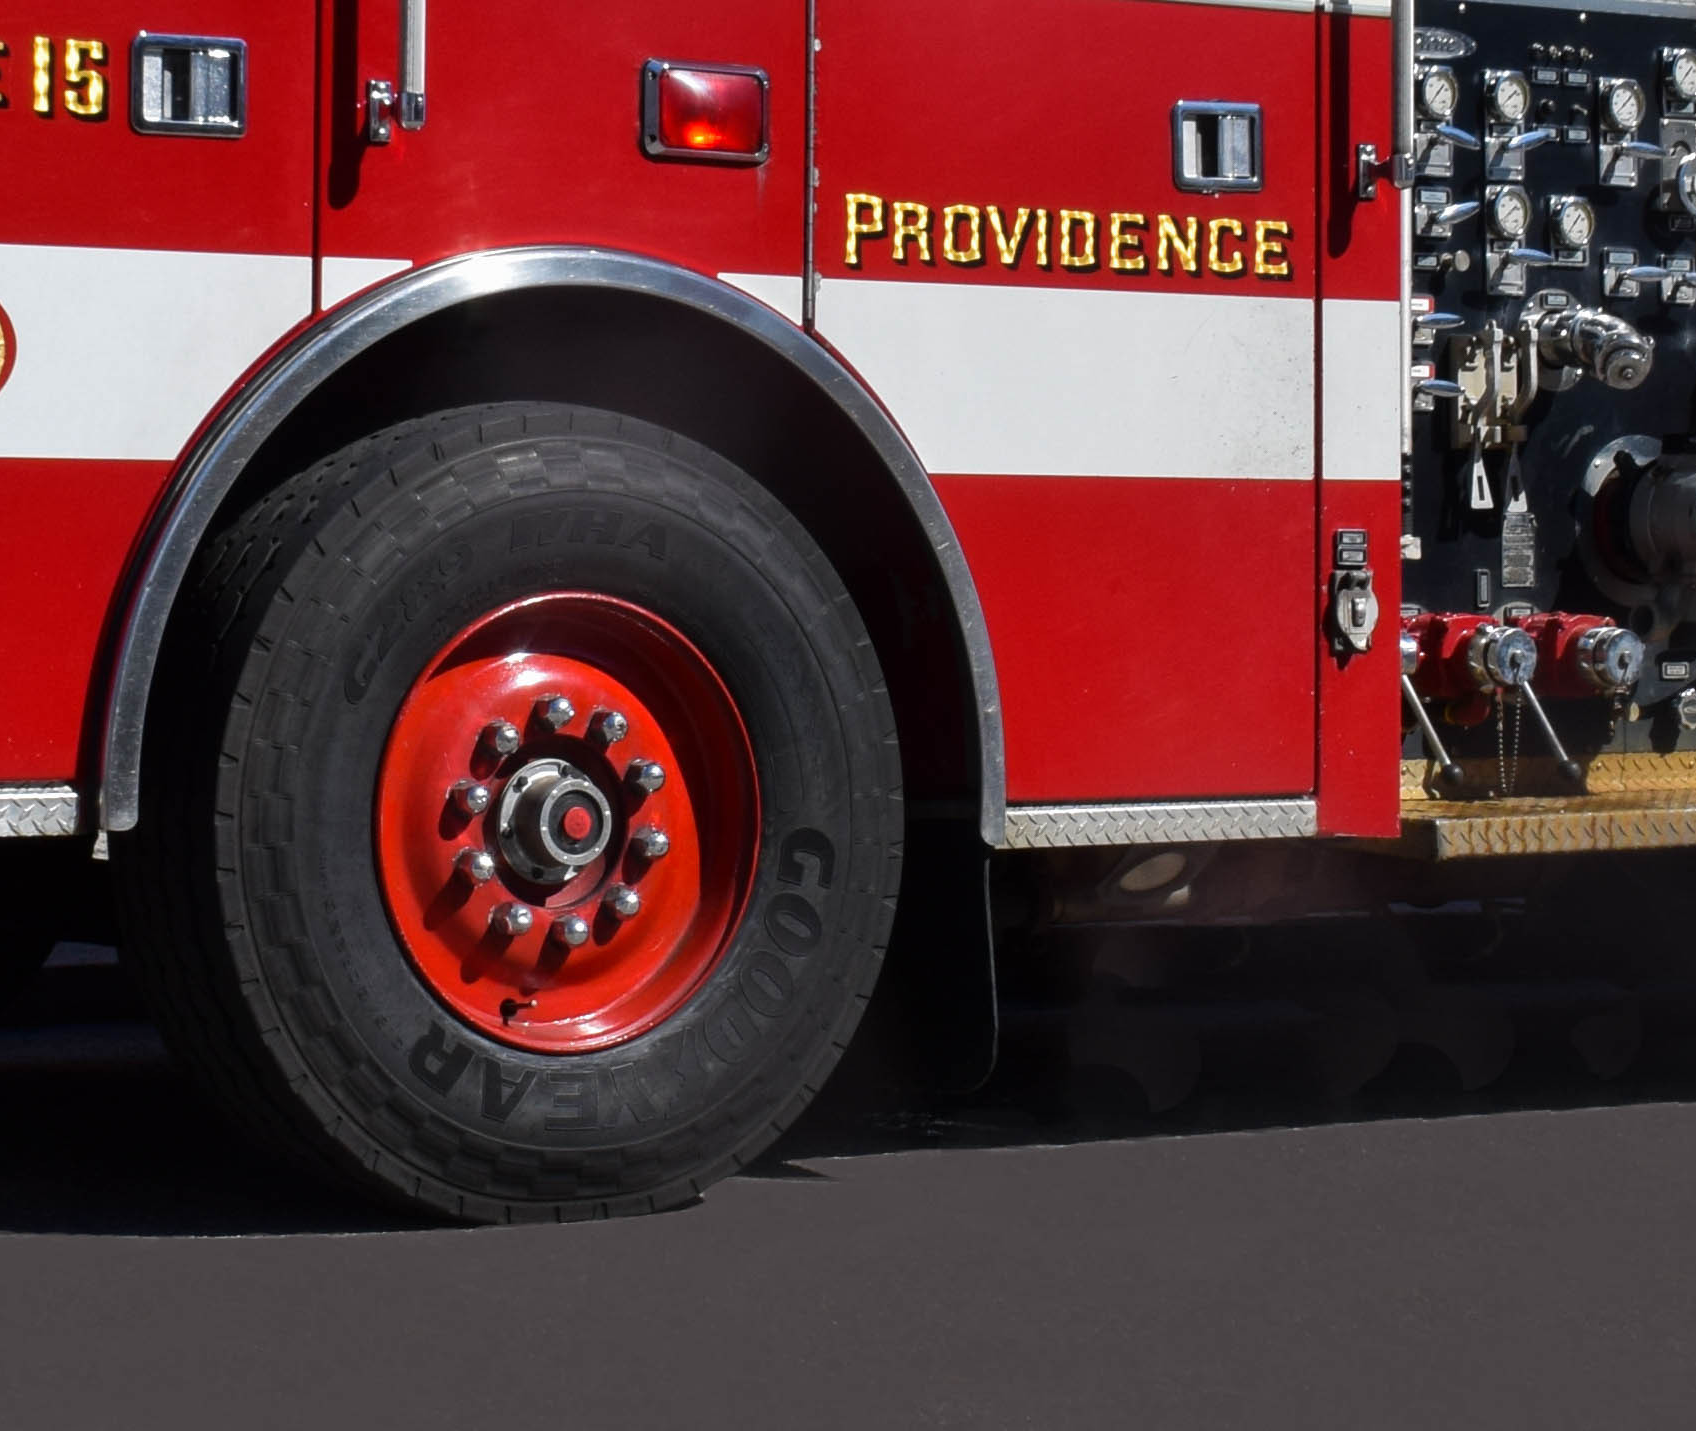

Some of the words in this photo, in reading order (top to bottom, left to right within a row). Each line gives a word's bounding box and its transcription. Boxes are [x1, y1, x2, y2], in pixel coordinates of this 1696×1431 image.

[31, 34, 109, 119] 15
[843, 191, 1292, 277] PROVIDENCE
[408, 826, 837, 1133] GOODYEAR
